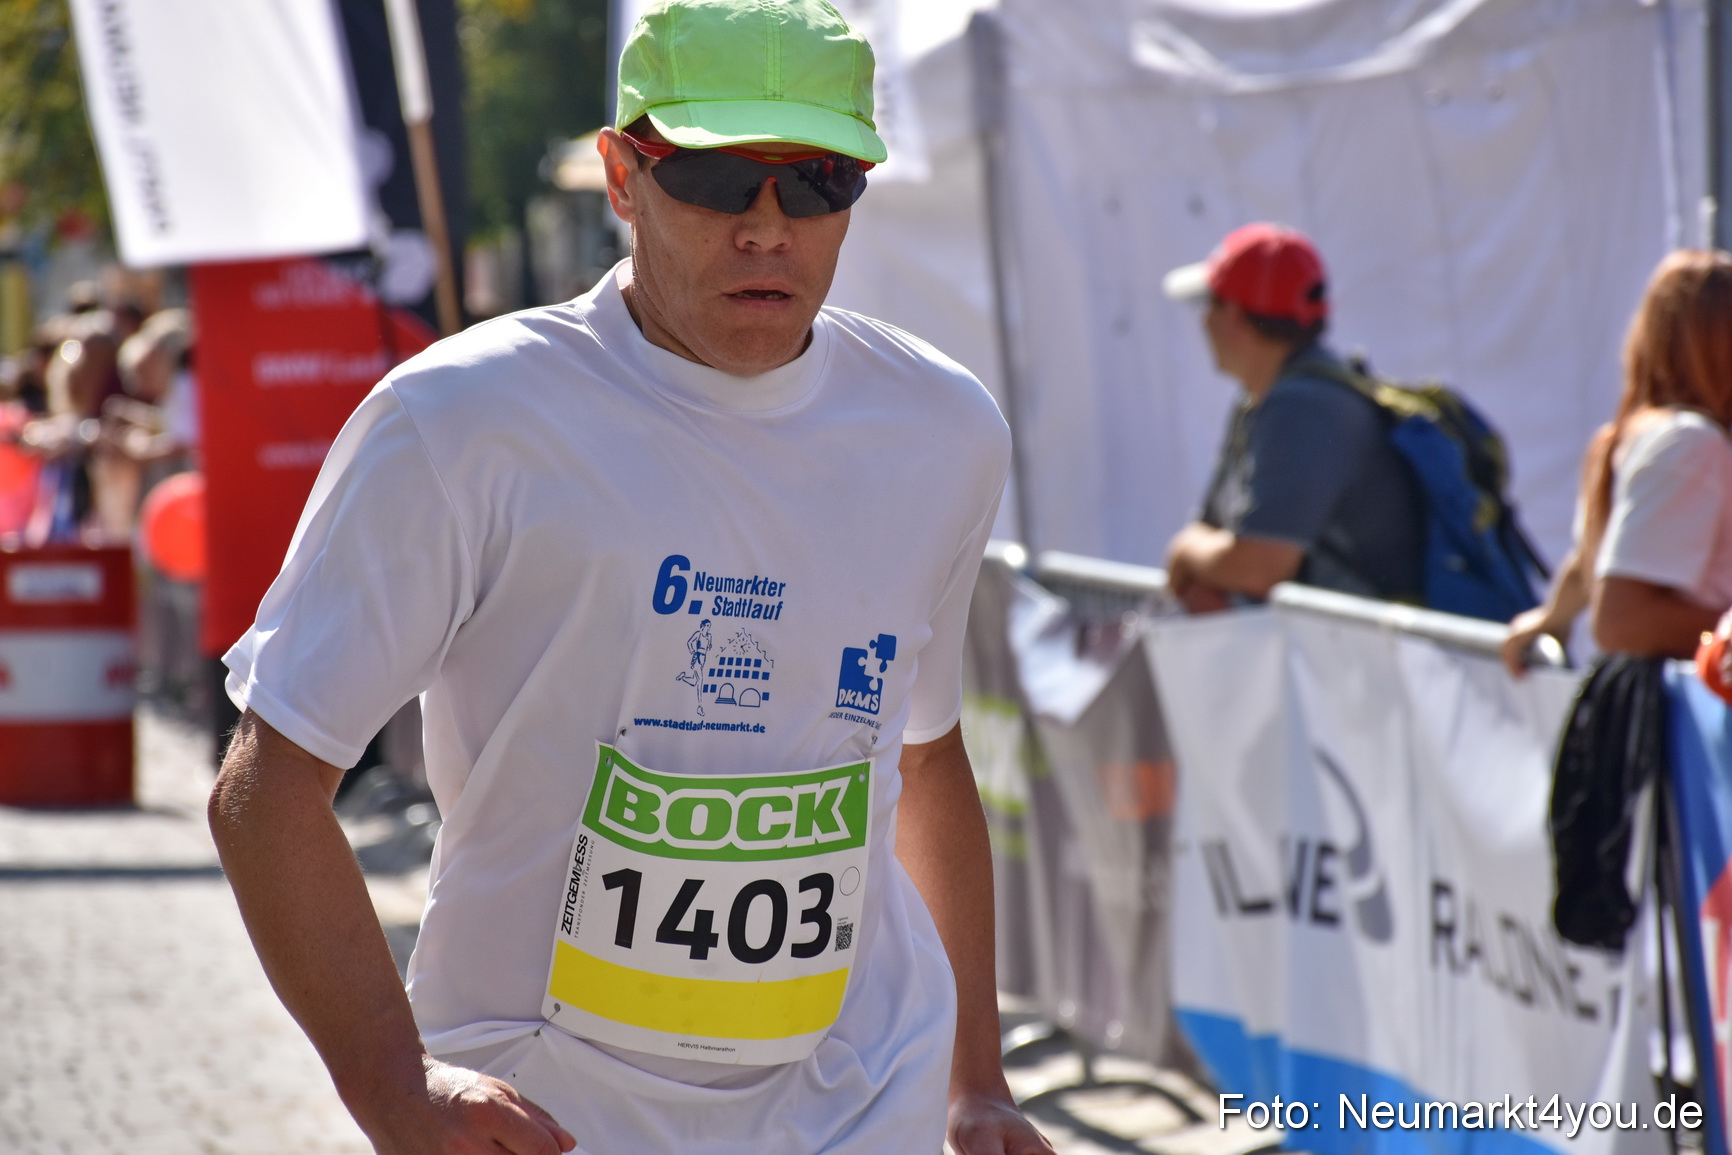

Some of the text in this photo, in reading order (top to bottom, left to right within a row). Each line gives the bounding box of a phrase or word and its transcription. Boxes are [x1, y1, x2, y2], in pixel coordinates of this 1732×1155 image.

[652, 554, 703, 615] 6.
[693, 571, 787, 598] Neumarkter
[711, 595, 784, 621] Stadtlauf
[837, 688, 880, 712] DKMS
[633, 716, 767, 734] www.stadtlauf-neumarkt.de
[598, 766, 852, 850] BOCK
[602, 867, 835, 964] 1403
[700, 1044, 736, 1053] Halbmarathon
